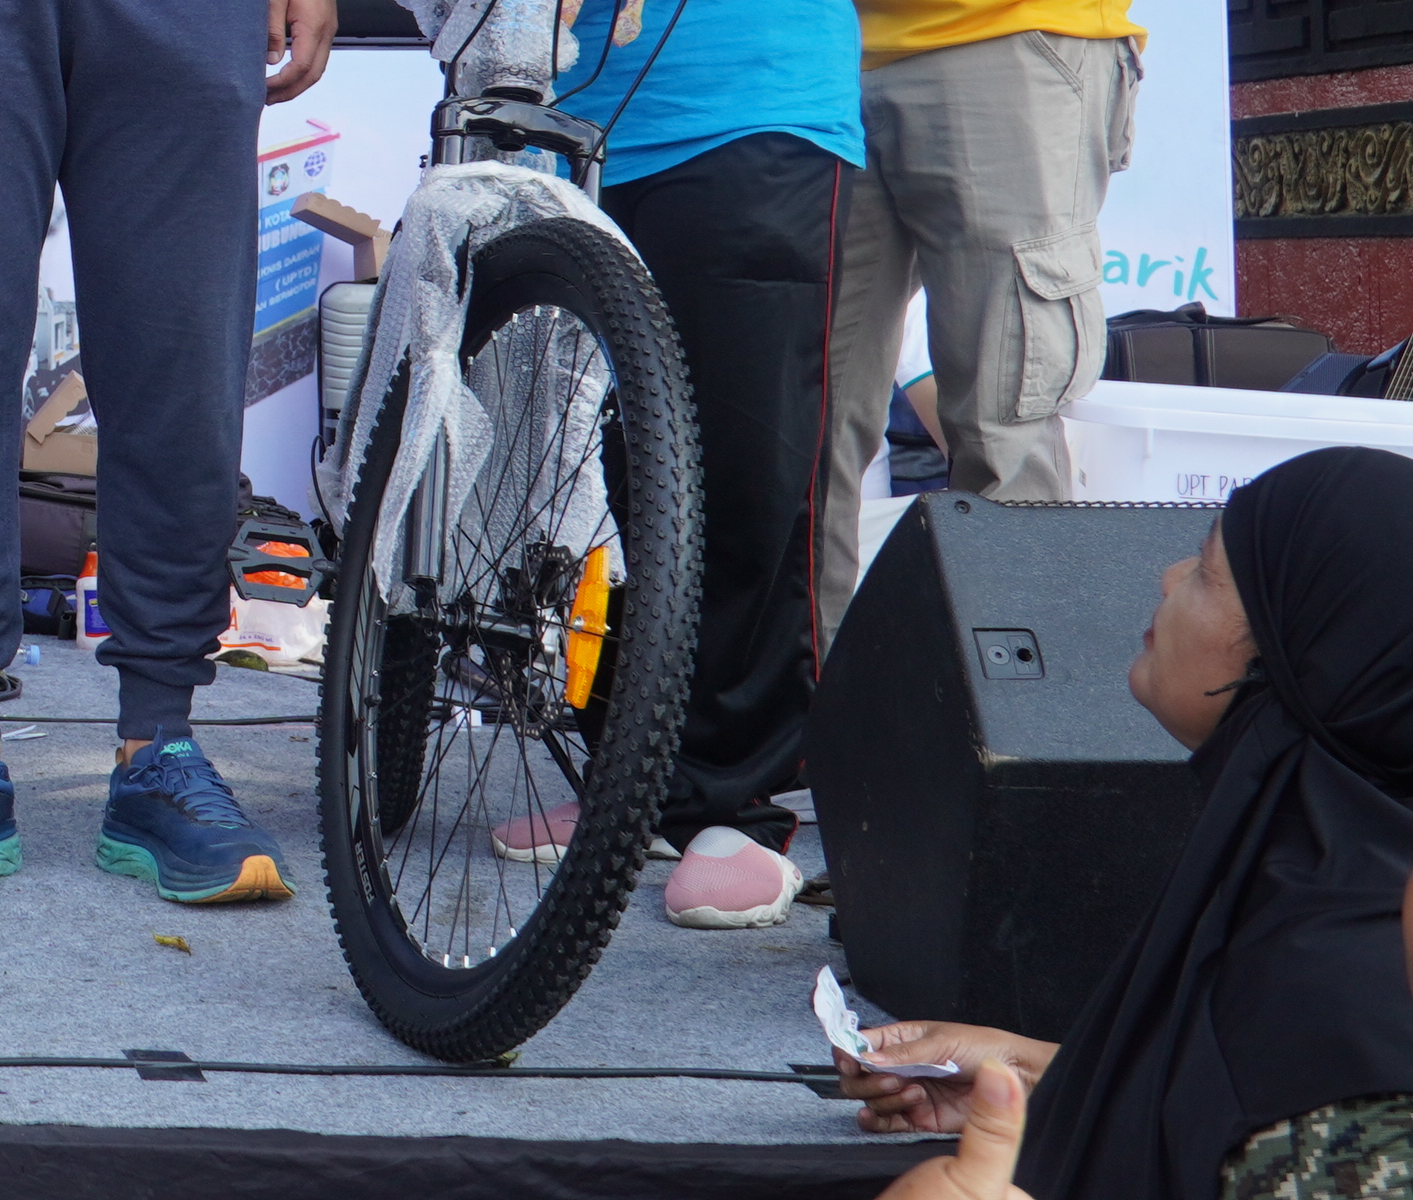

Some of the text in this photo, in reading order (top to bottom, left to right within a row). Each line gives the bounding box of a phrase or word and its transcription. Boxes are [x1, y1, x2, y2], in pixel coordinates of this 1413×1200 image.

[1103, 247, 1218, 301] arik
[1176, 473, 1211, 496] UPT
[354, 840, 375, 907] FOSTER
